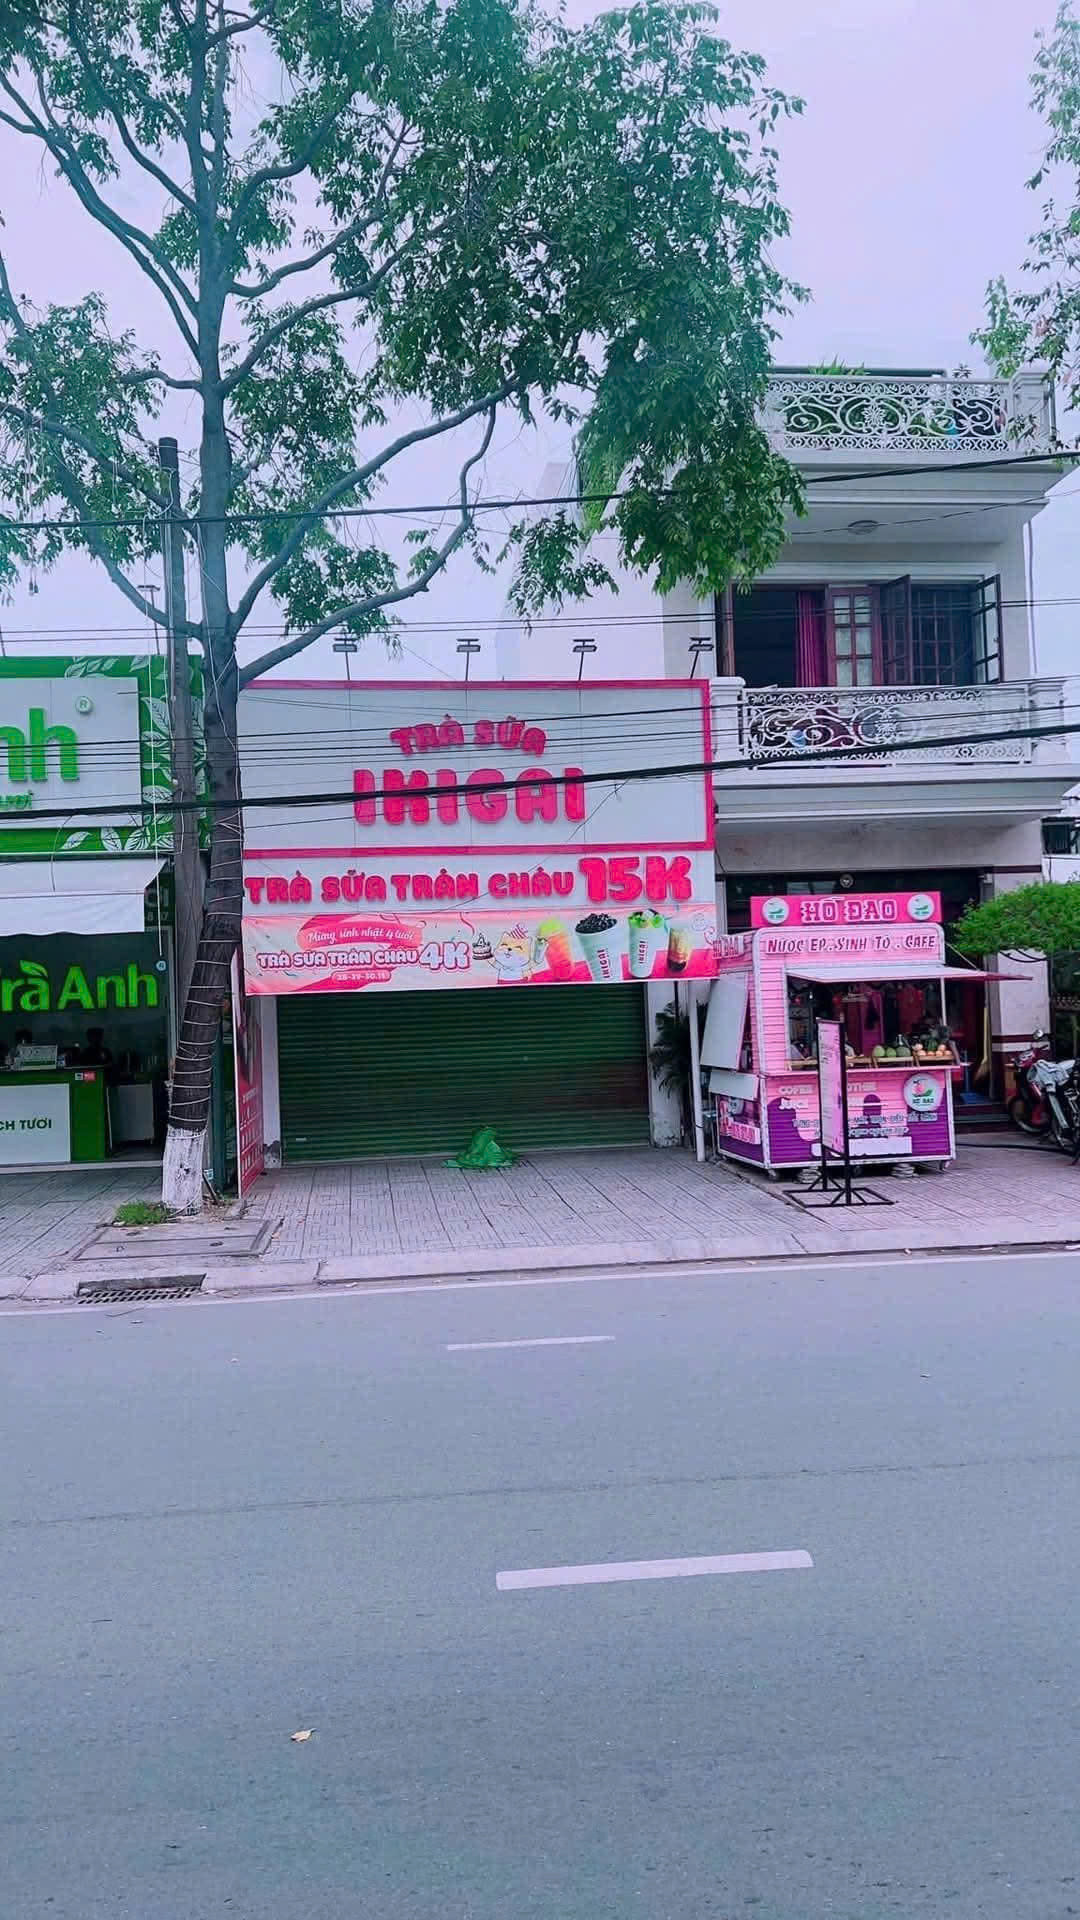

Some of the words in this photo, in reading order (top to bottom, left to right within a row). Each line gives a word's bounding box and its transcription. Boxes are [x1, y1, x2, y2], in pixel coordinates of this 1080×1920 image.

[390, 714, 464, 756] TRÀ
[474, 715, 547, 757] SỮA
[353, 768, 586, 825] IKIGAI
[244, 870, 312, 904] TRÀ
[321, 869, 387, 903] SỮA
[488, 866, 574, 899] CHÂU
[579, 856, 692, 904] 15K
[257, 950, 292, 969] TRÀ
[419, 942, 470, 970] 4K
[57, 963, 158, 1010] Anh
